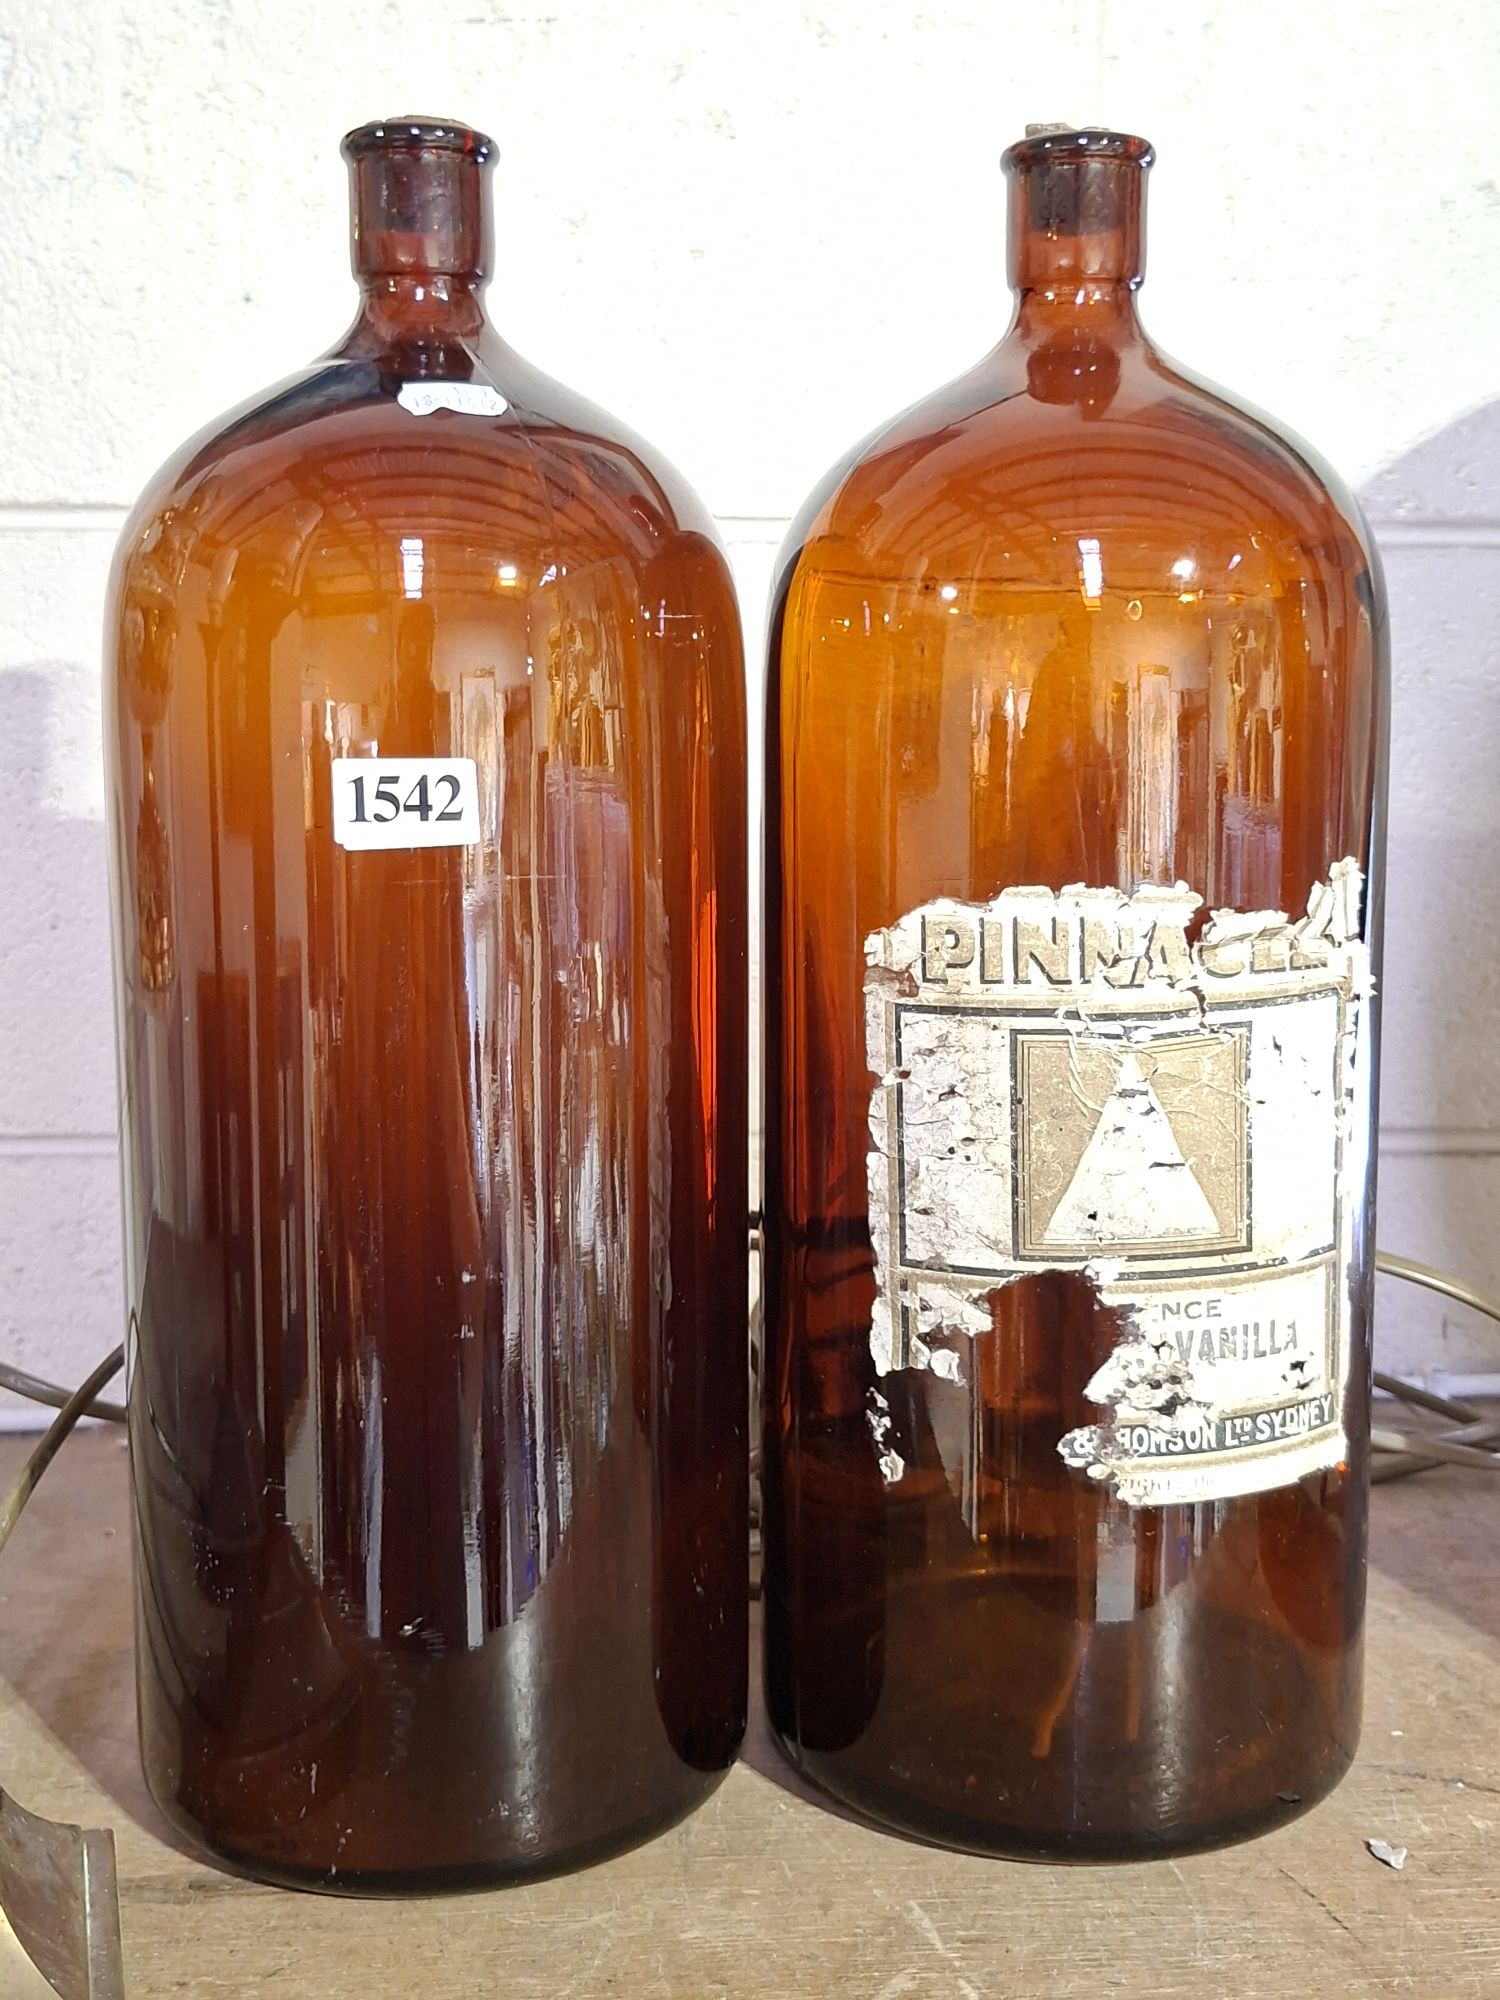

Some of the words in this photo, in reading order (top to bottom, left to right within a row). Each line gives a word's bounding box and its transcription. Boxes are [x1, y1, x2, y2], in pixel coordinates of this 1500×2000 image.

[347, 774, 464, 823] 1542
[1175, 1318, 1298, 1362] VANILLA
[1115, 1422, 1217, 1454] HOMSON
[1256, 1394, 1332, 1441] SYDNEY
